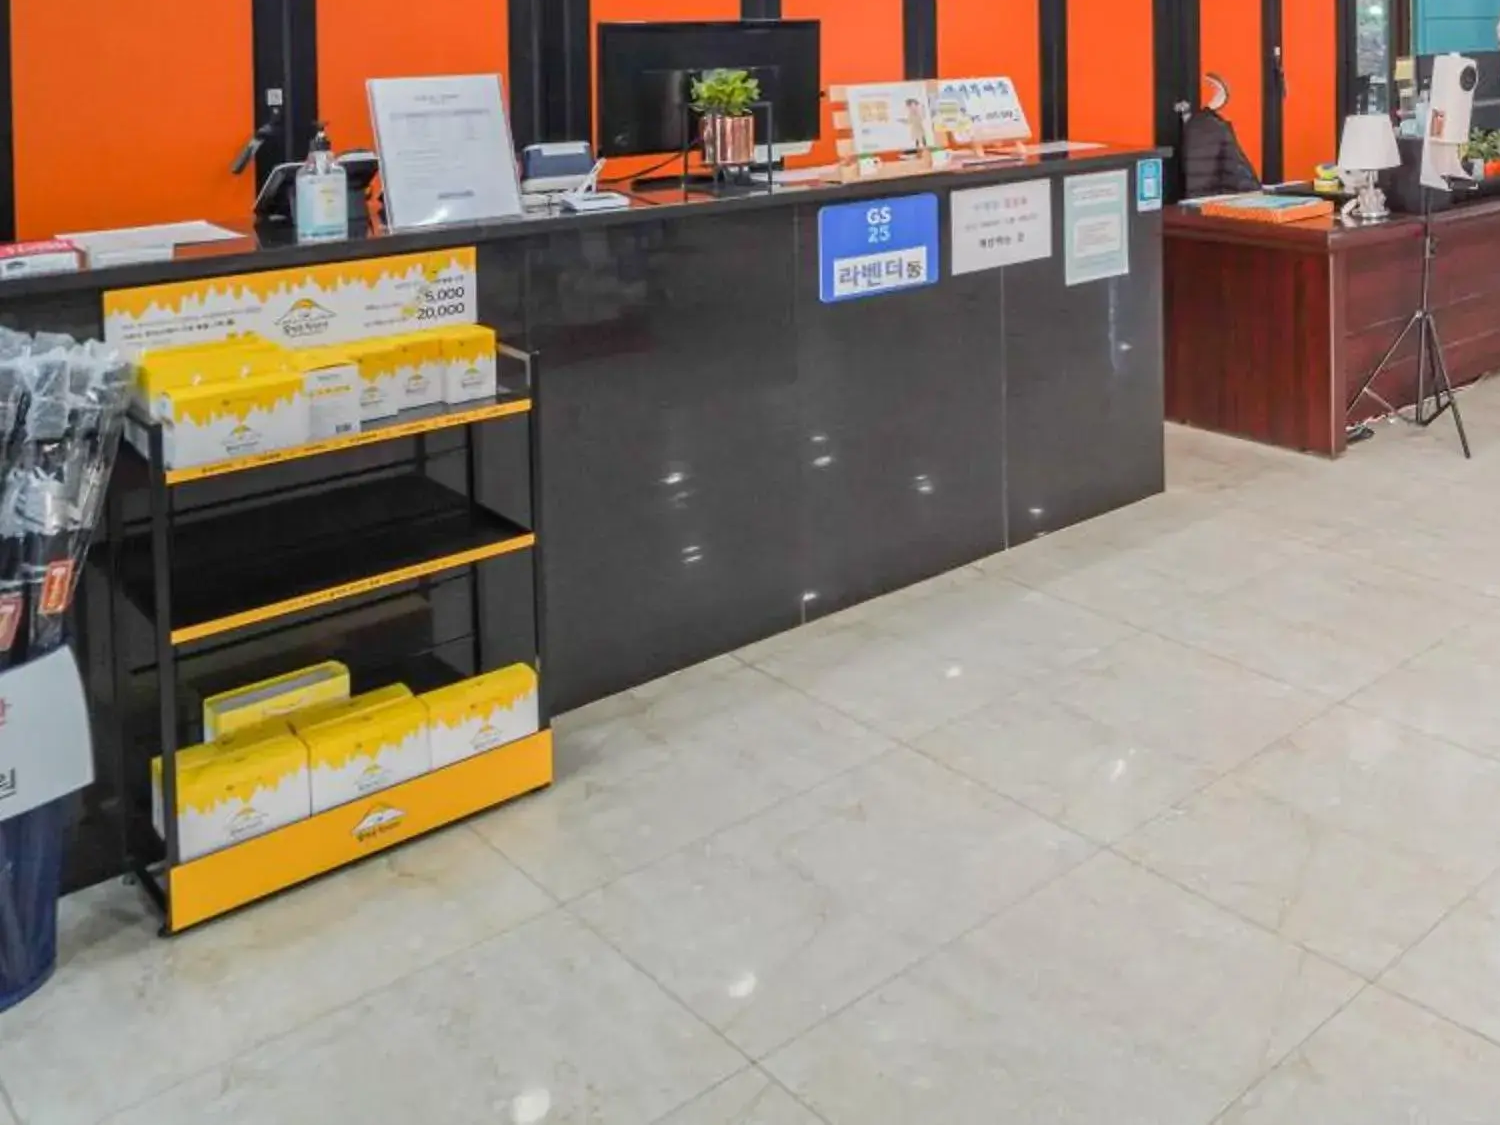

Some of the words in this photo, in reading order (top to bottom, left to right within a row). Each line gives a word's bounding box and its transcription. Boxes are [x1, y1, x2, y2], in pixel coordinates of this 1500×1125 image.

[866, 207, 892, 225] GS
[868, 226, 891, 243] 25
[838, 257, 923, 286] 라벤더동
[417, 302, 465, 320] 20,000
